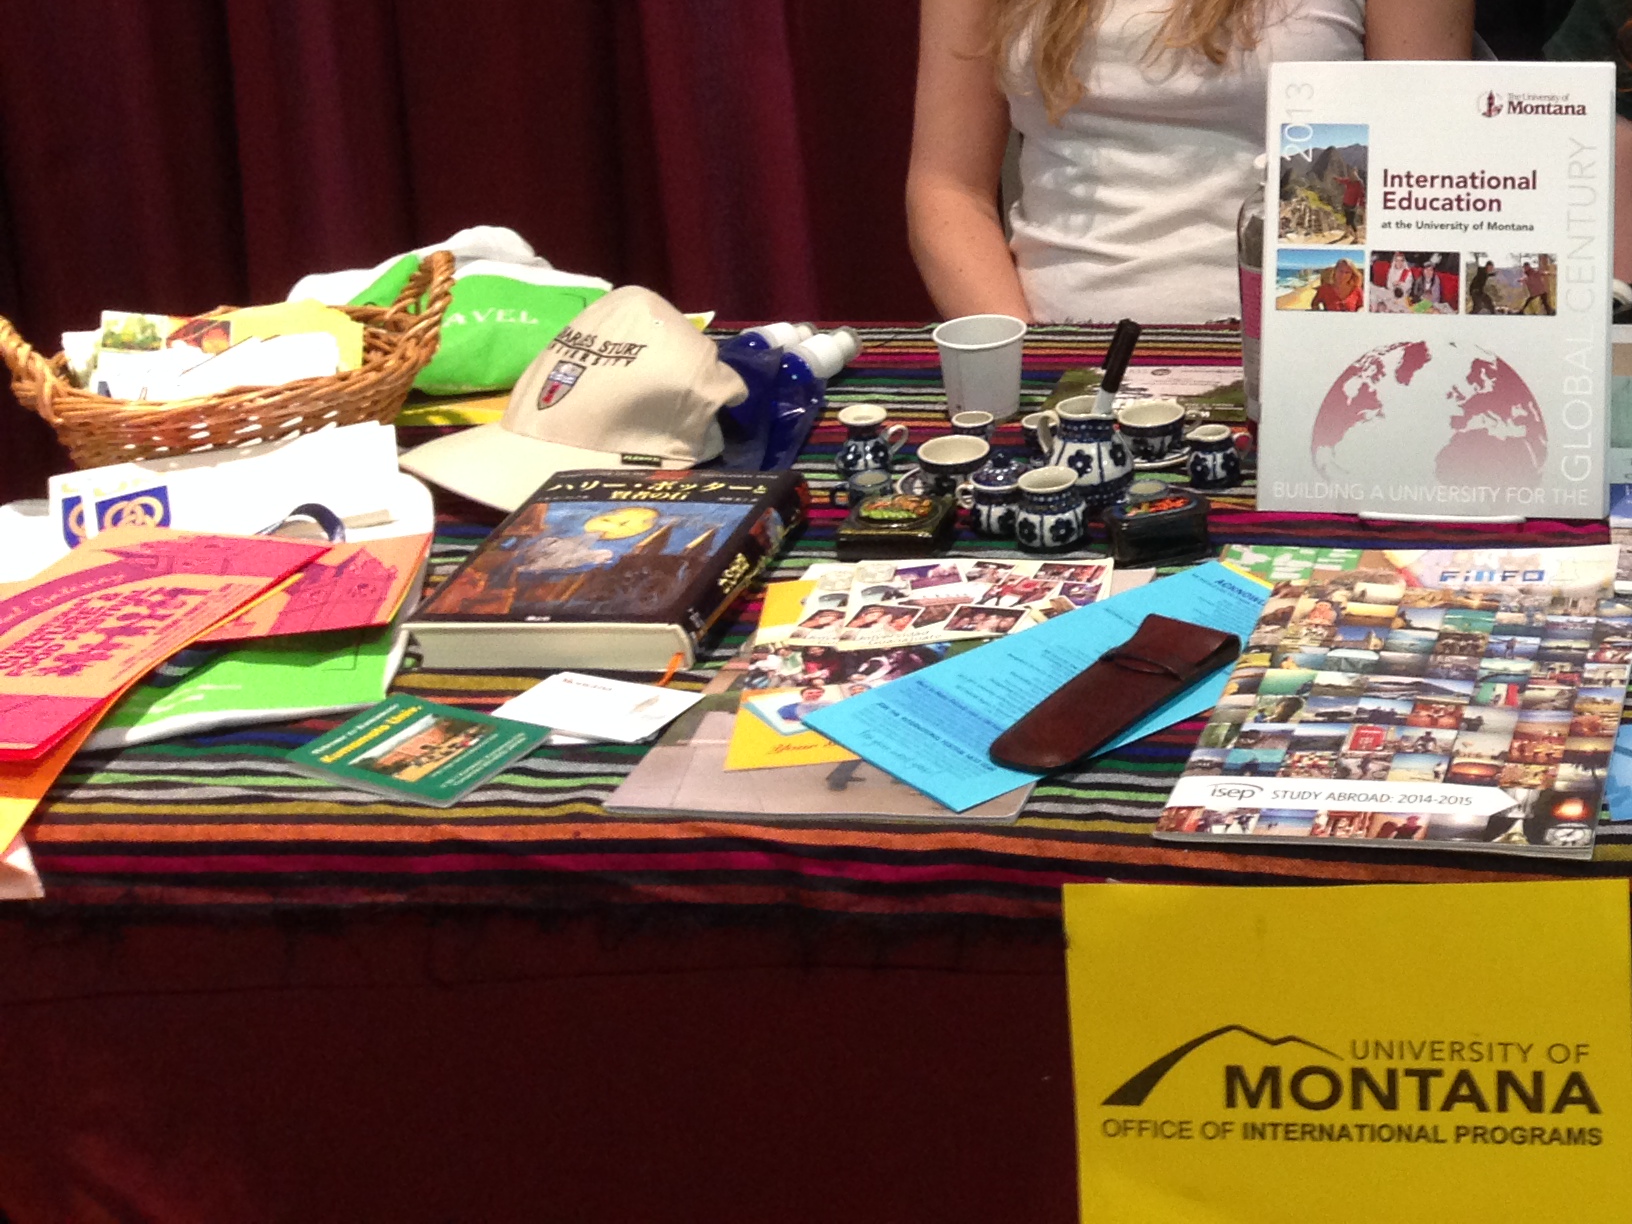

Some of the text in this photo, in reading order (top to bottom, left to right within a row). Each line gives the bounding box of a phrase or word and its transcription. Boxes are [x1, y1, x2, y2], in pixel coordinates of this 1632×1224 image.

[1507, 101, 1587, 116] Montana
[1284, 81, 1315, 163] 2013
[1383, 168, 1537, 191] International
[1383, 190, 1502, 213] Education
[1381, 219, 1535, 234] at the University of Montana
[1561, 136, 1598, 483] GLOBAL CENTURY
[599, 340, 648, 357] STURT
[1272, 480, 1589, 506] BUILDING A UNIVERSITY FOR THE
[1209, 784, 1473, 807] isep STUDY ABROAD: 2014-2015
[1350, 1039, 1591, 1064] UNIVERSITY OF
[1224, 1064, 1604, 1116] MONTANA
[1102, 1117, 1604, 1147] OFFICE OF INTERNATIONAL PROGRAMS
